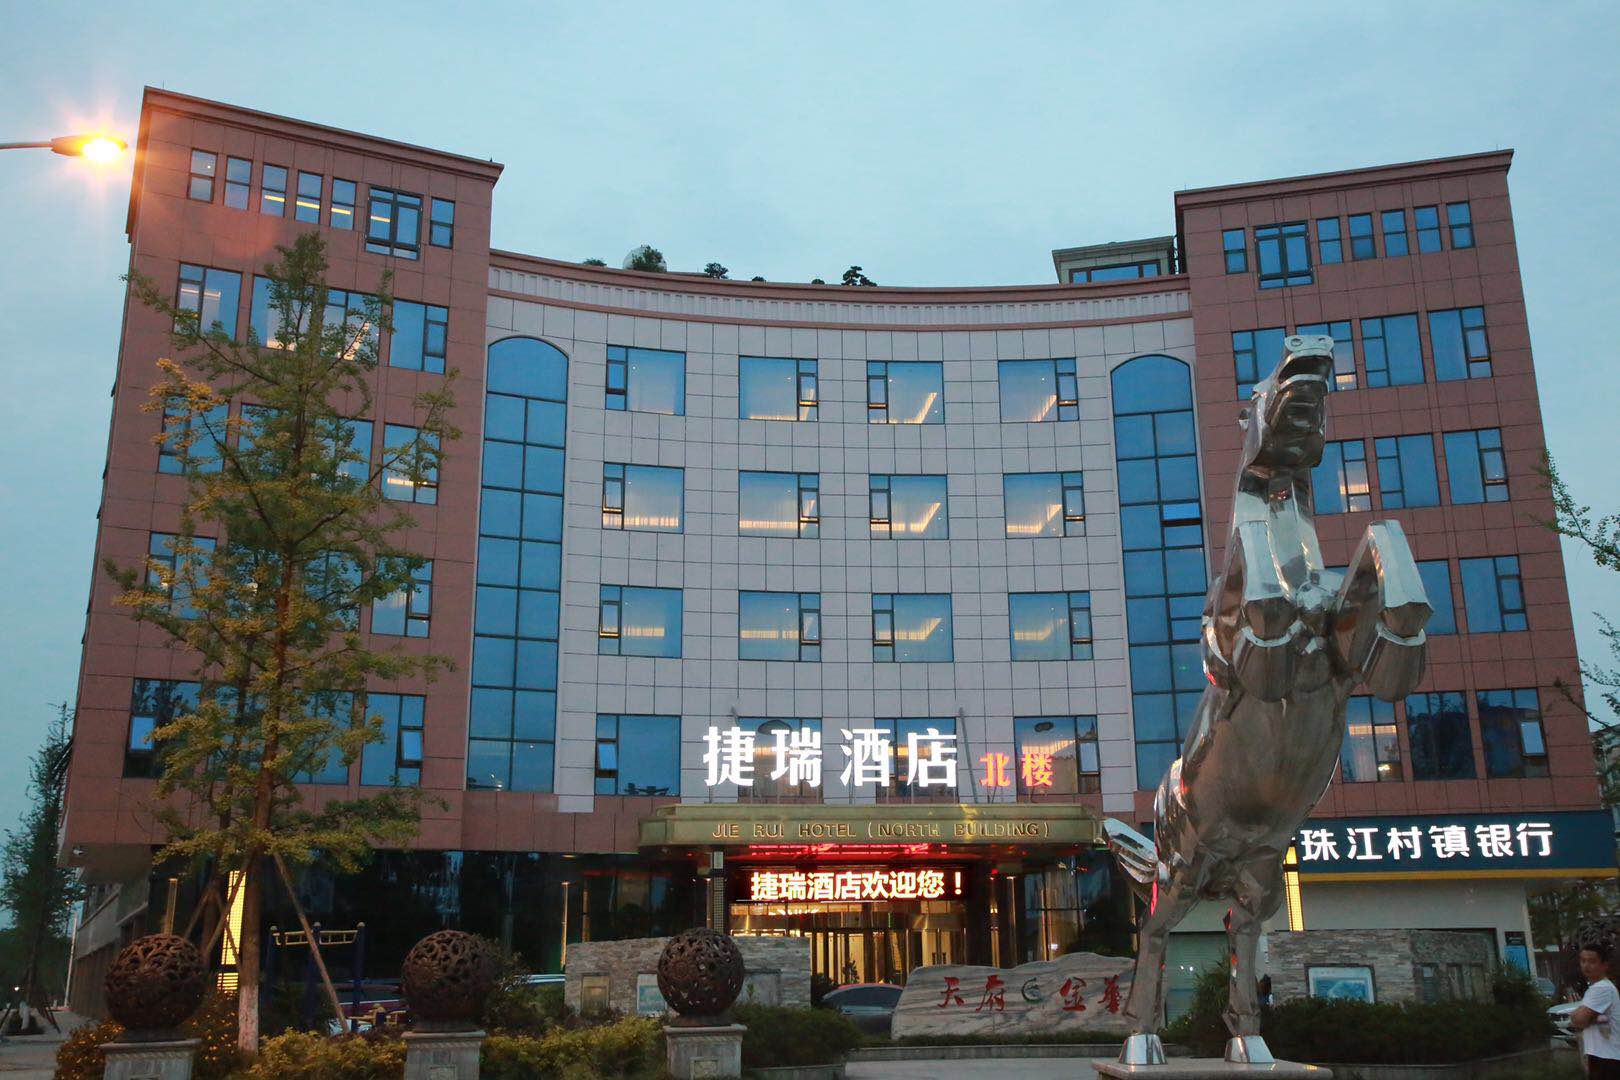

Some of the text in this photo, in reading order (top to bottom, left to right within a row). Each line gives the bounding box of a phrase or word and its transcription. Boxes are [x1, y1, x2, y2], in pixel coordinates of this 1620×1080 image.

[703, 726, 1054, 788] 捷瑞酒店 北楼
[712, 822, 1050, 838] JIE RUI HOTEL (NORTH BUILDING)
[1291, 822, 1553, 861] 珠江村镇银行
[750, 869, 962, 900] 捷瑞酒店欢迎您！
[937, 974, 1006, 1013] 天府
